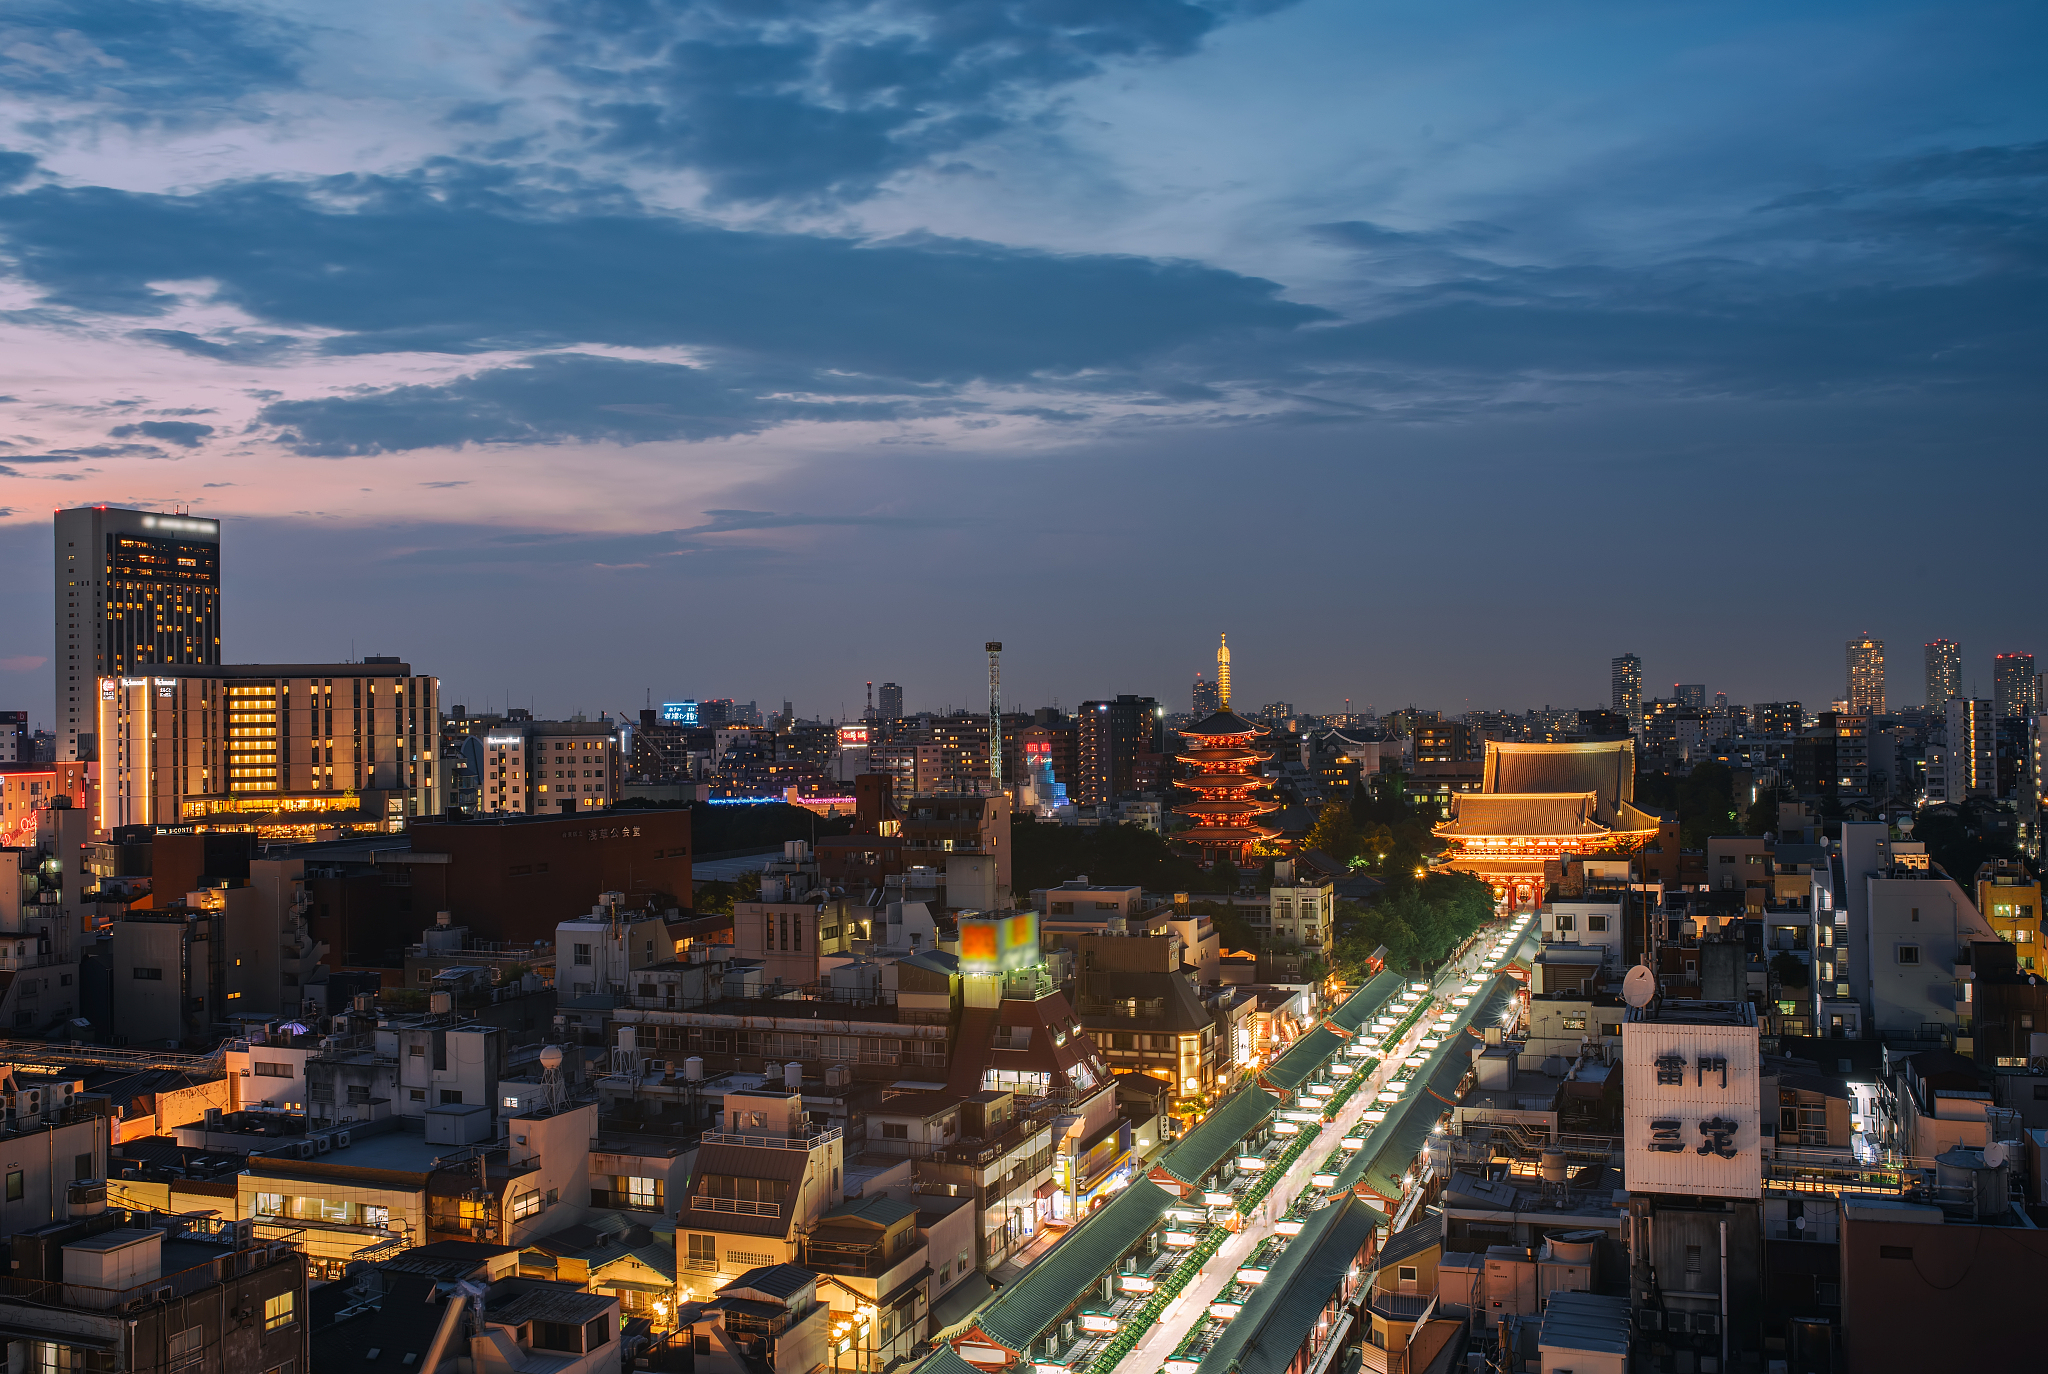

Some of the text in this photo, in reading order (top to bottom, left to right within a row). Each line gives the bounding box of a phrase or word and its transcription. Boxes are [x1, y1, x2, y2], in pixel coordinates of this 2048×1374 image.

[588, 825, 641, 841] 浅草公会堂
[1654, 1055, 1727, 1089] 雷門
[1648, 1117, 1739, 1160] 三定
